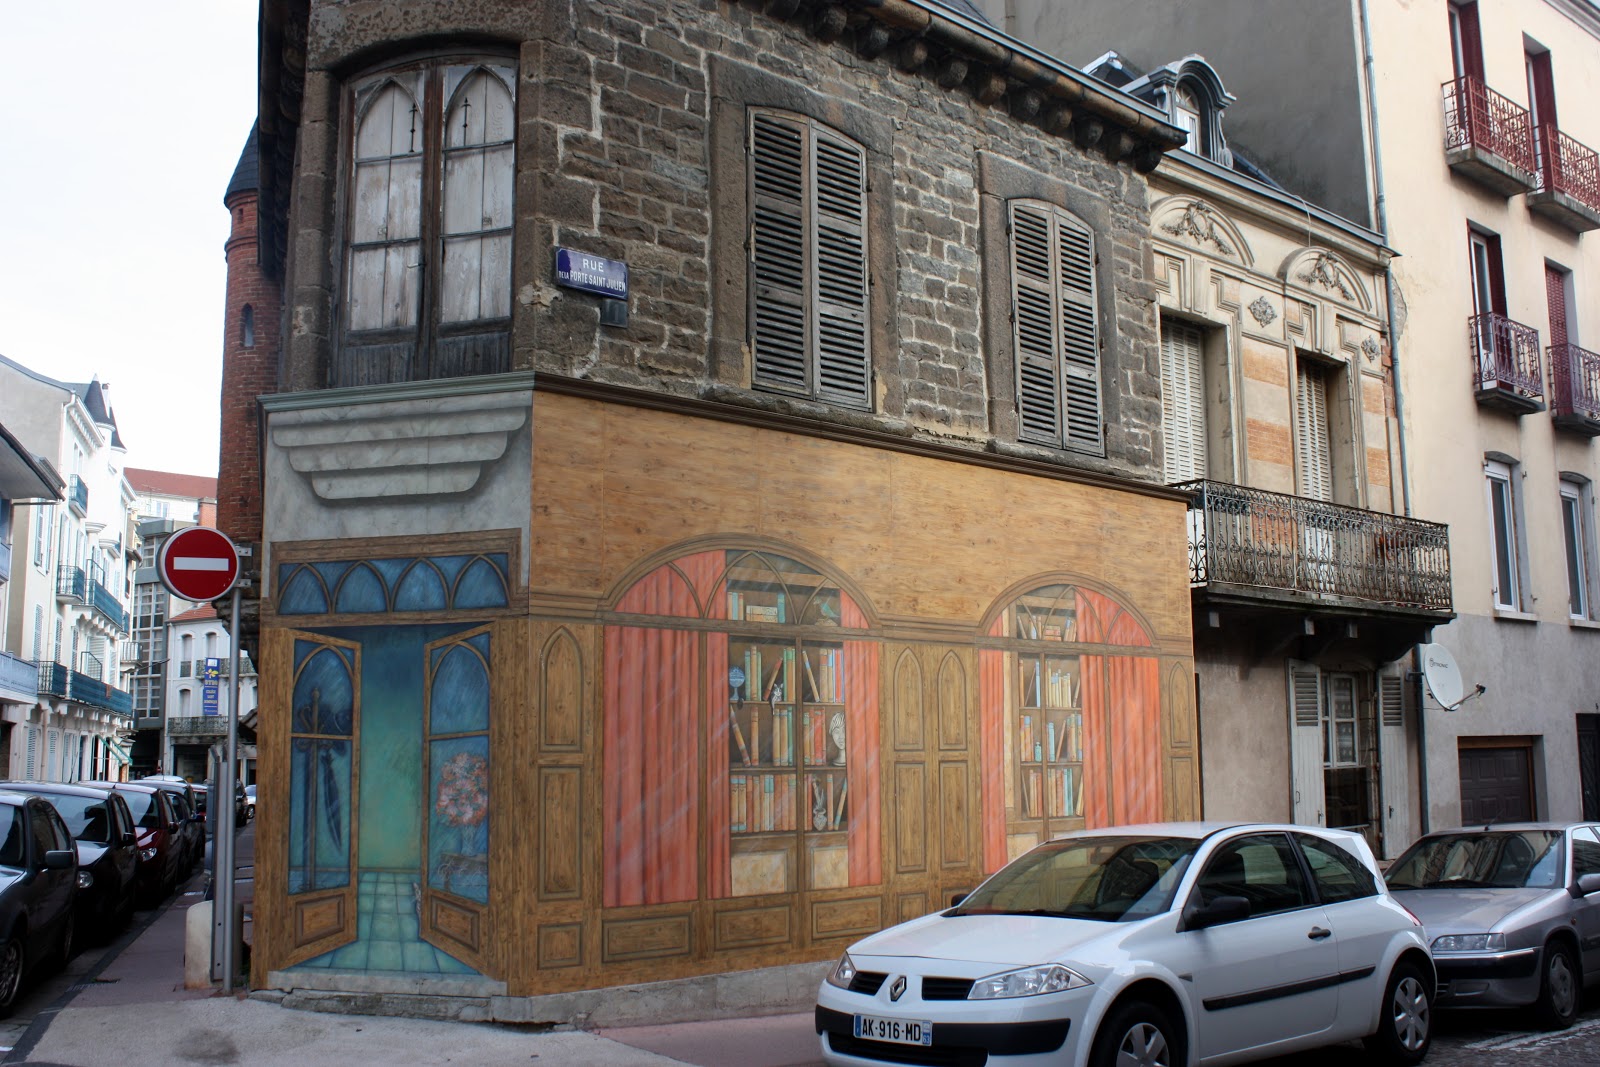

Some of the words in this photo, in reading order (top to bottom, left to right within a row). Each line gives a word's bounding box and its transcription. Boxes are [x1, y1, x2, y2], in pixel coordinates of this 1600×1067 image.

[583, 258, 604, 272] RUE
[570, 271, 588, 283] PORTE
[589, 275, 605, 288] SAINT
[606, 279, 626, 292] JULIEN
